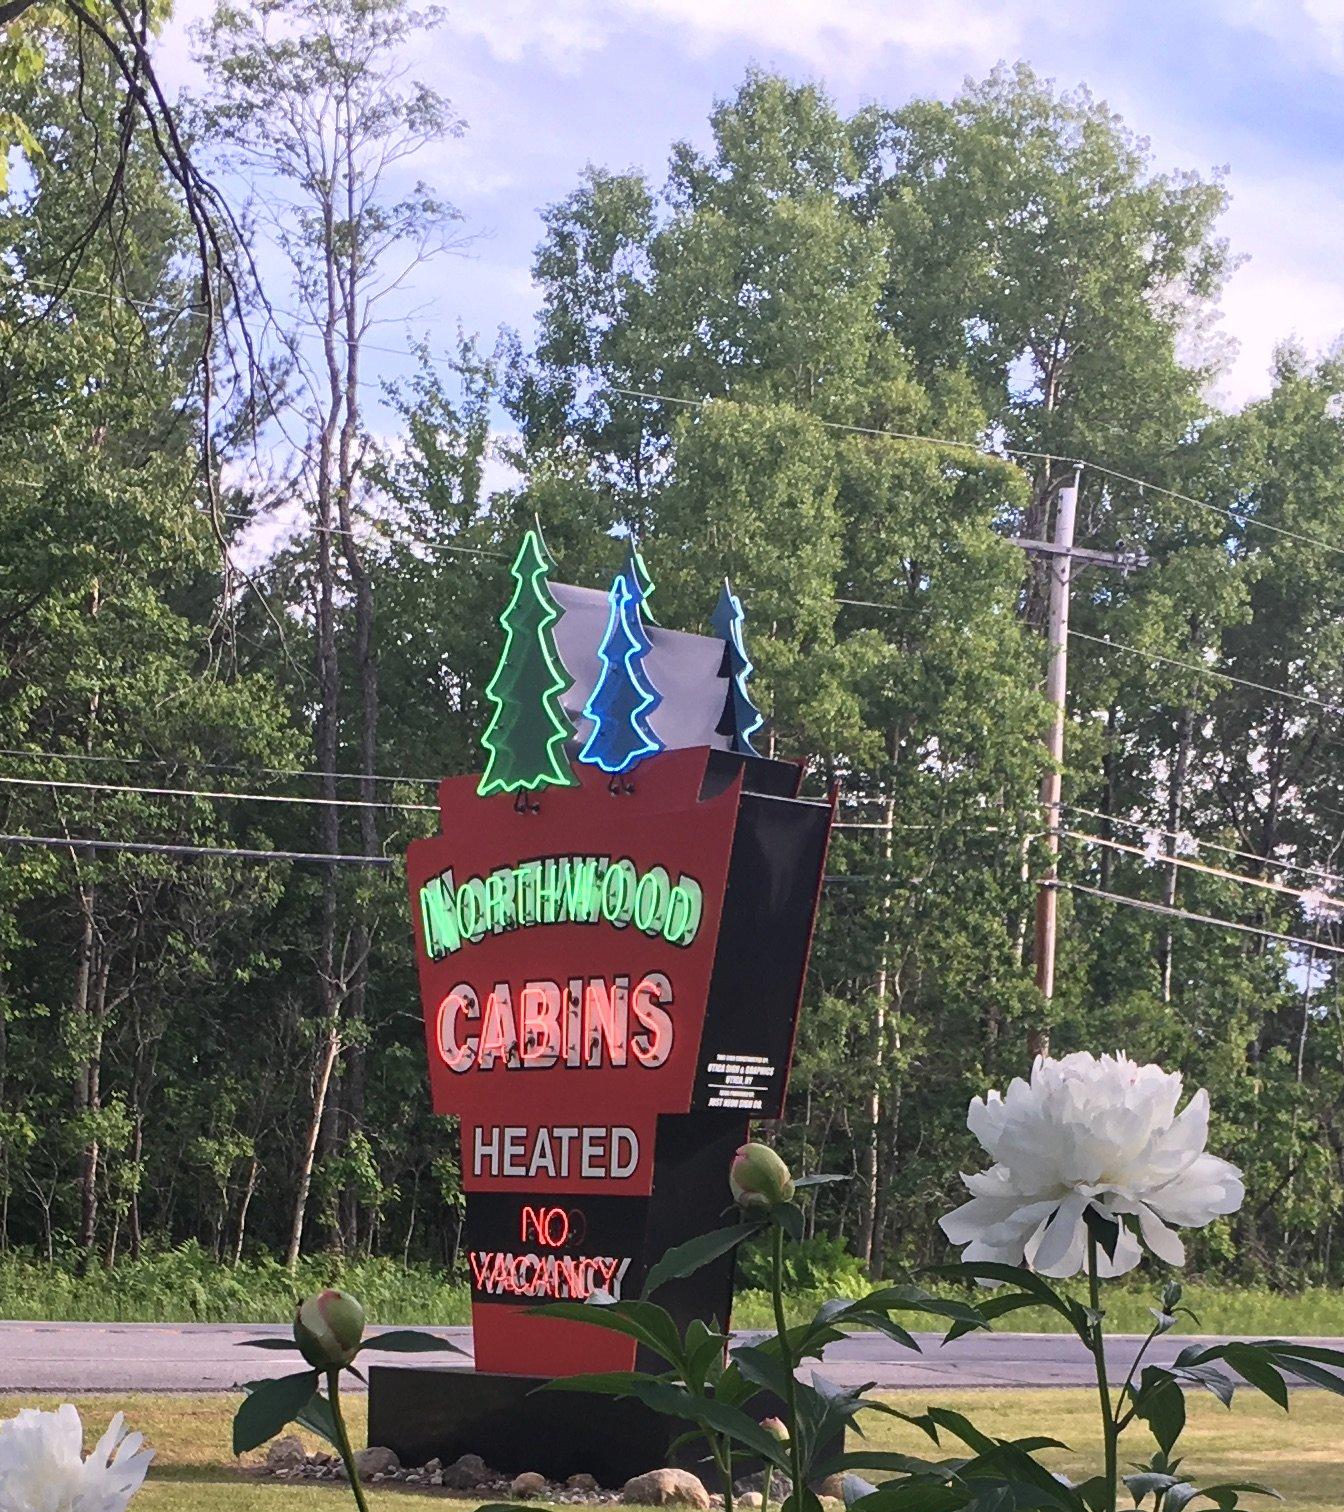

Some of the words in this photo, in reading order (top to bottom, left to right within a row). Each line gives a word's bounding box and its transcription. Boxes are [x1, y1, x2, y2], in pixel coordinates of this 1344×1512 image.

[419, 855, 703, 960] NORTHWOOD
[436, 971, 674, 1073] CABINS
[473, 1126, 640, 1178] HEATED
[521, 1206, 568, 1246] NO
[470, 1251, 632, 1300] VACANCY
